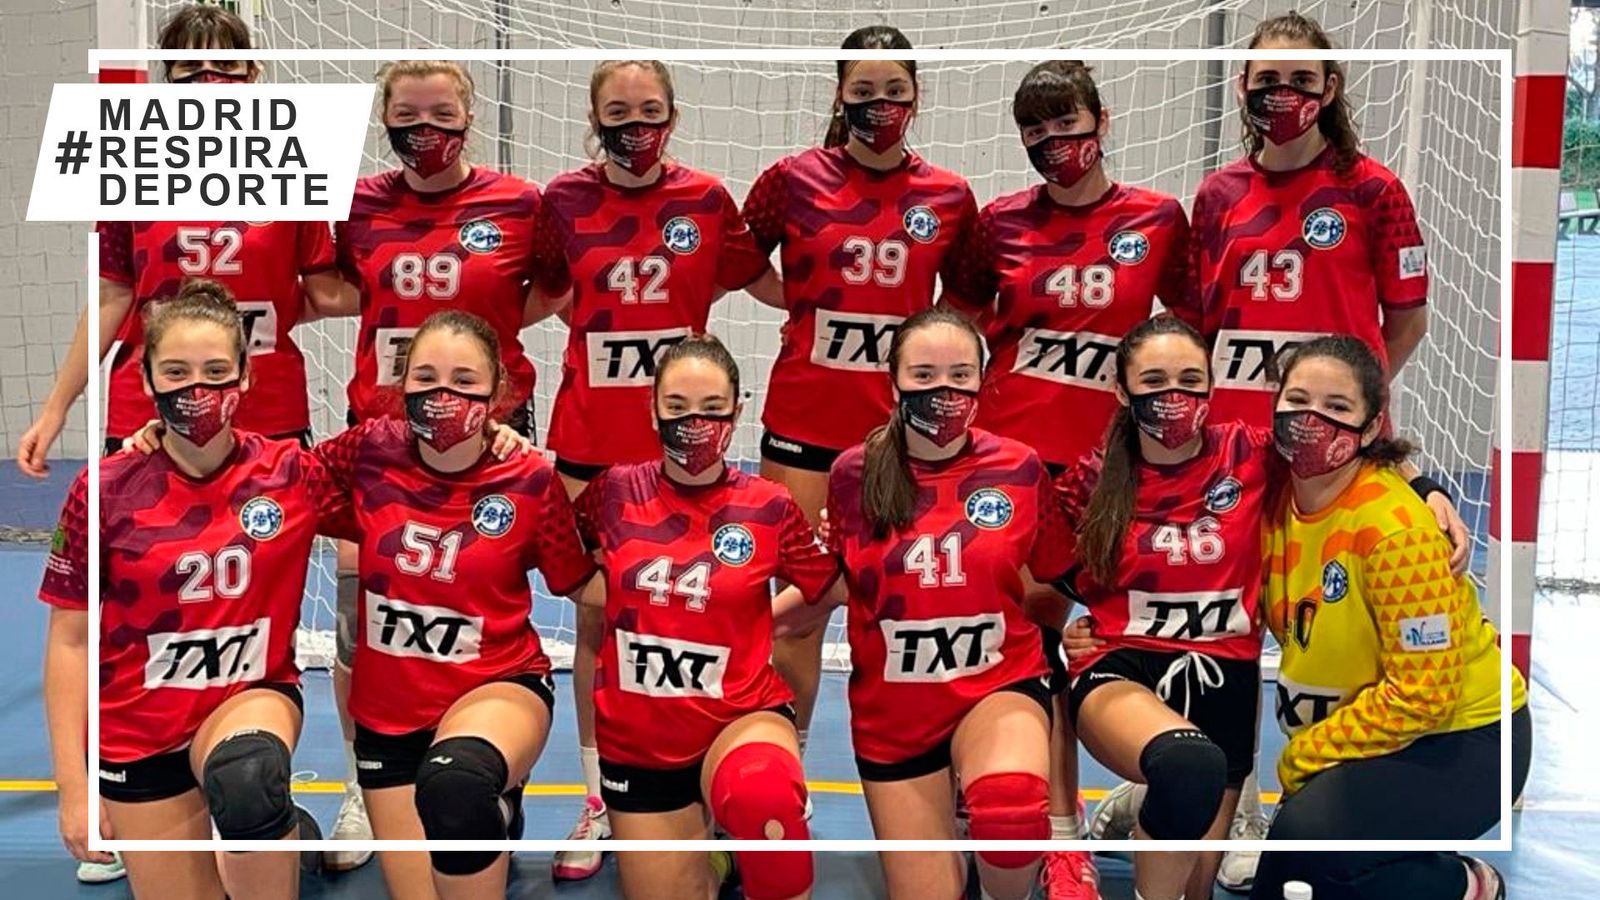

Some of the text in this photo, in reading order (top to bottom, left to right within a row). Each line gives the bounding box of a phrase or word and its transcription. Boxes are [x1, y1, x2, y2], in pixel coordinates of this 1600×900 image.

[177, 226, 243, 276] 52
[392, 252, 462, 301] 89
[841, 235, 908, 288] 39
[1240, 249, 1304, 302] 43
[607, 255, 670, 305] 42
[1045, 264, 1115, 309] 48
[394, 519, 464, 584] 51
[903, 532, 967, 589] 41
[1151, 516, 1226, 566] 46
[175, 544, 252, 604] 20
[635, 555, 712, 613] 44
[1277, 682, 1341, 727] XT
